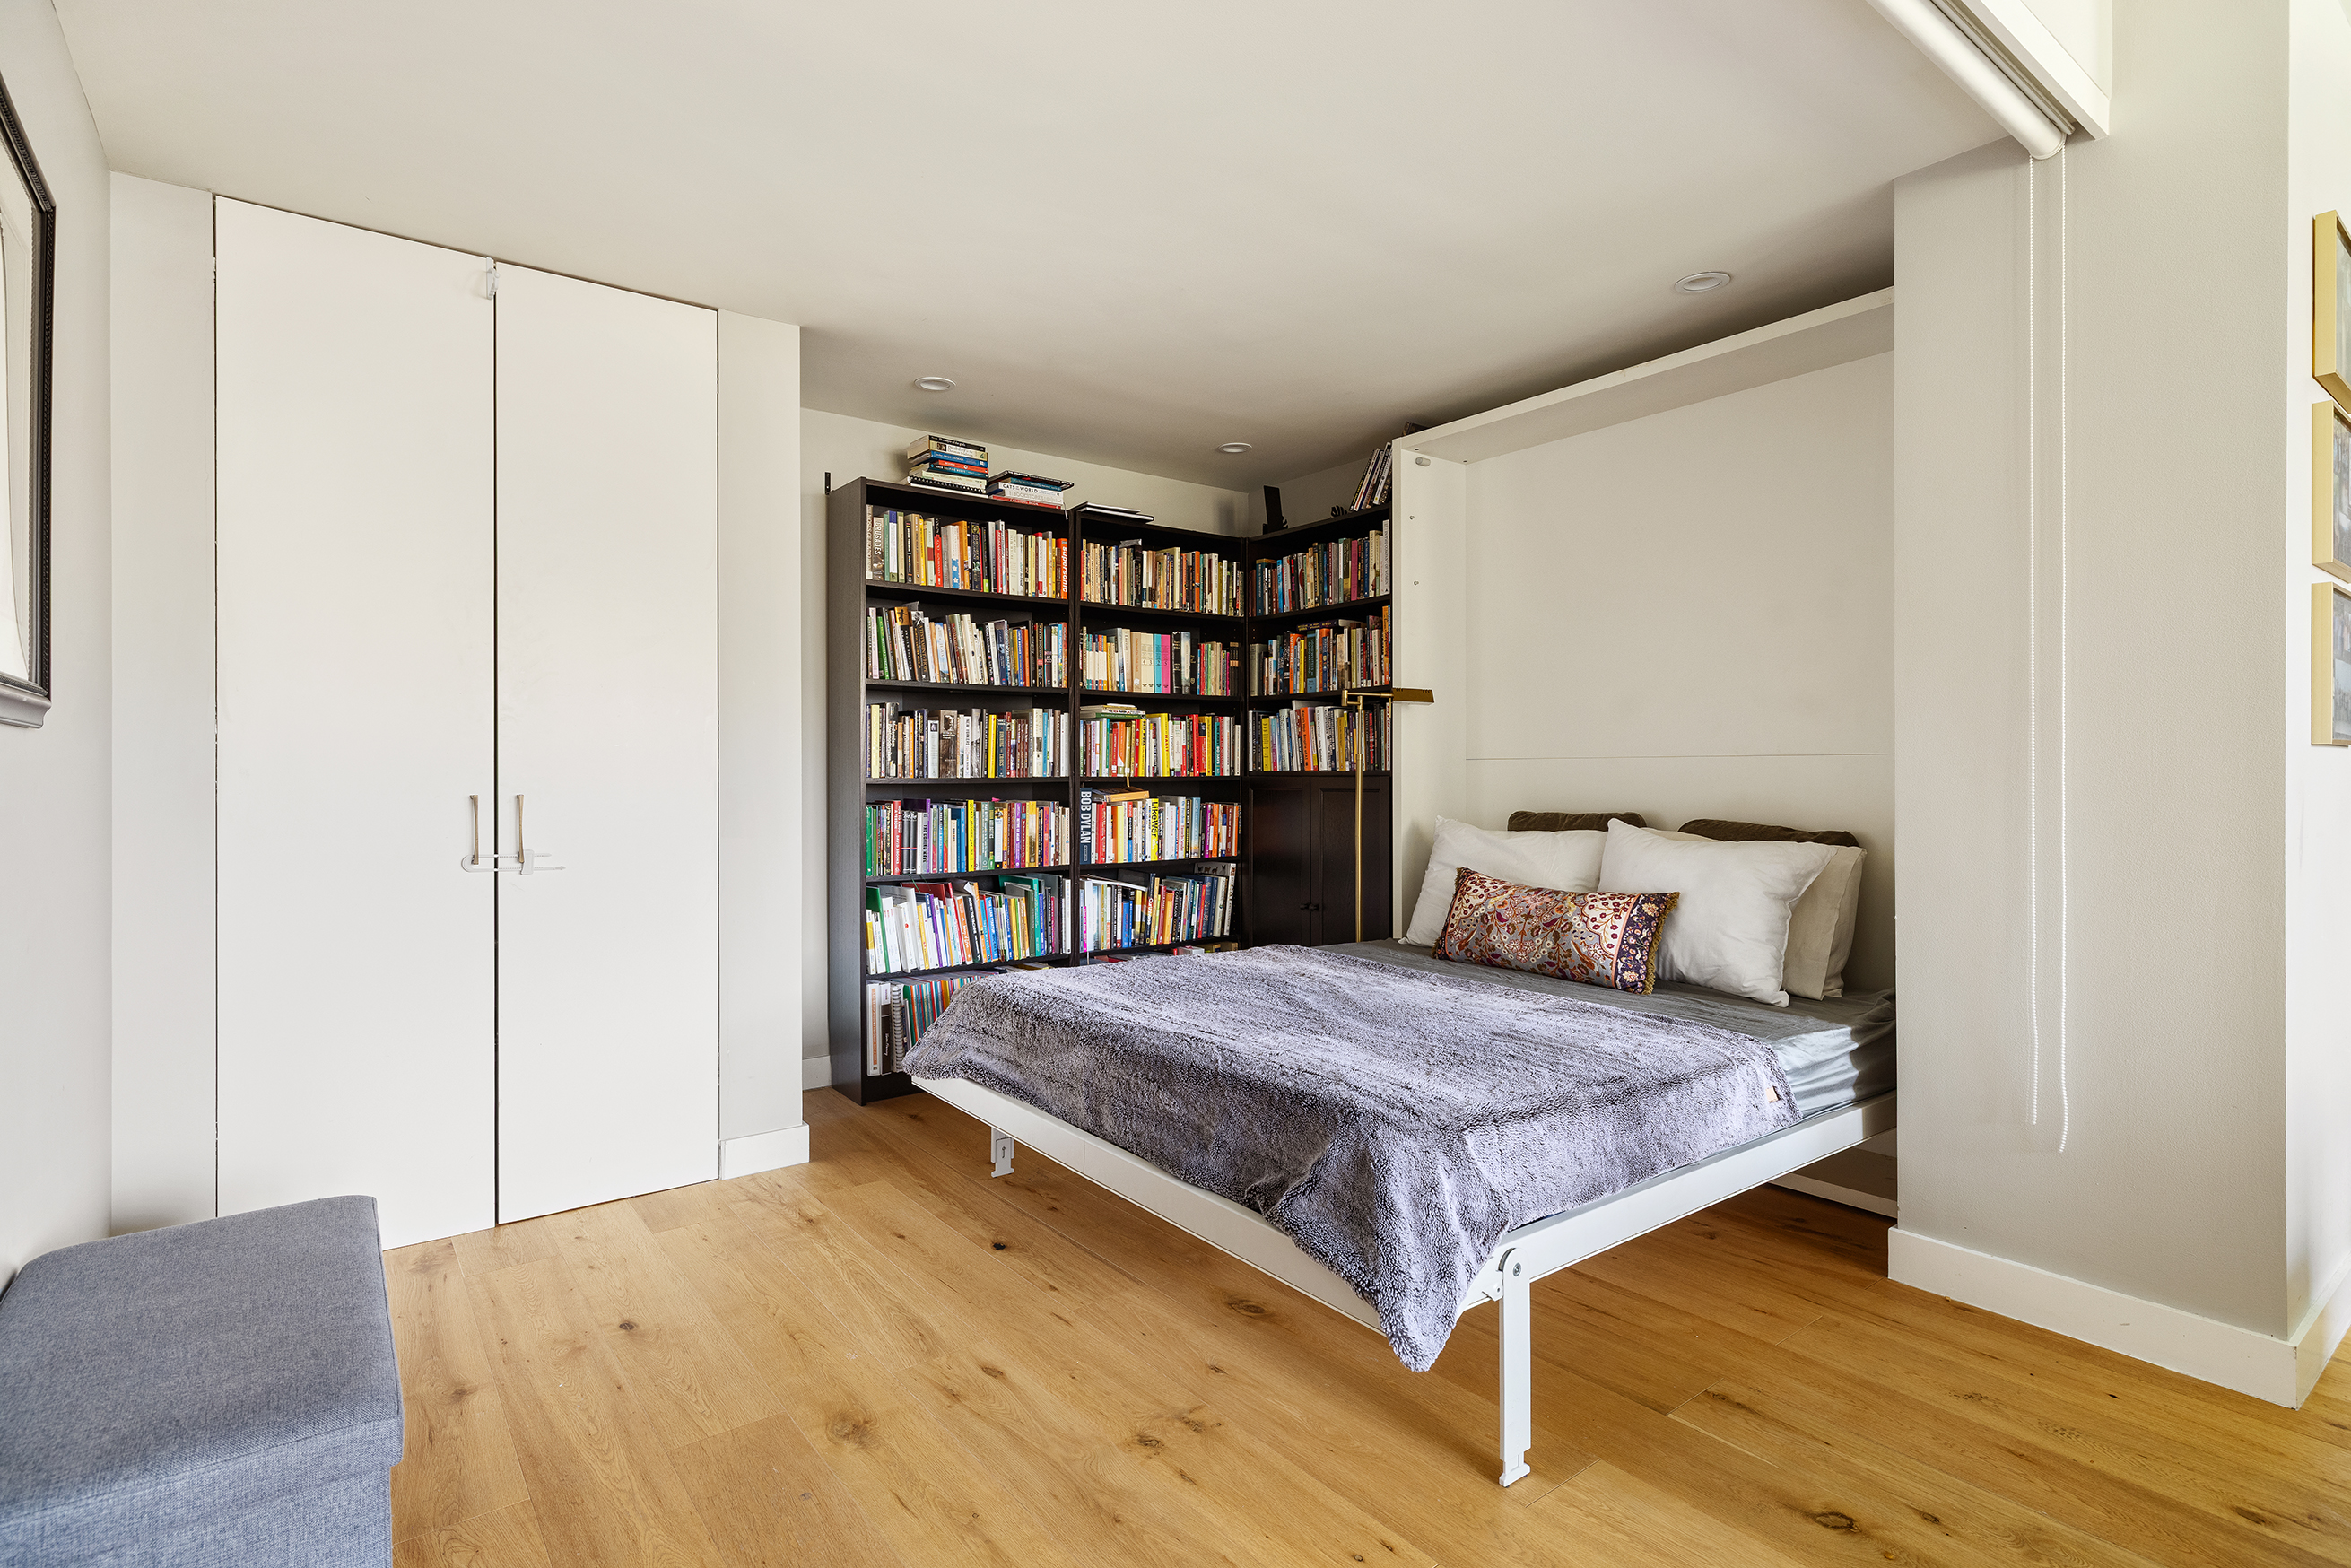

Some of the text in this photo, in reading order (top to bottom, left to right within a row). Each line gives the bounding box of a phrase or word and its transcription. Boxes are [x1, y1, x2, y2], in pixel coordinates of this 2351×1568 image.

[874, 522, 882, 555] CRUSADES
[1080, 791, 1092, 844] BOB DYLAN
